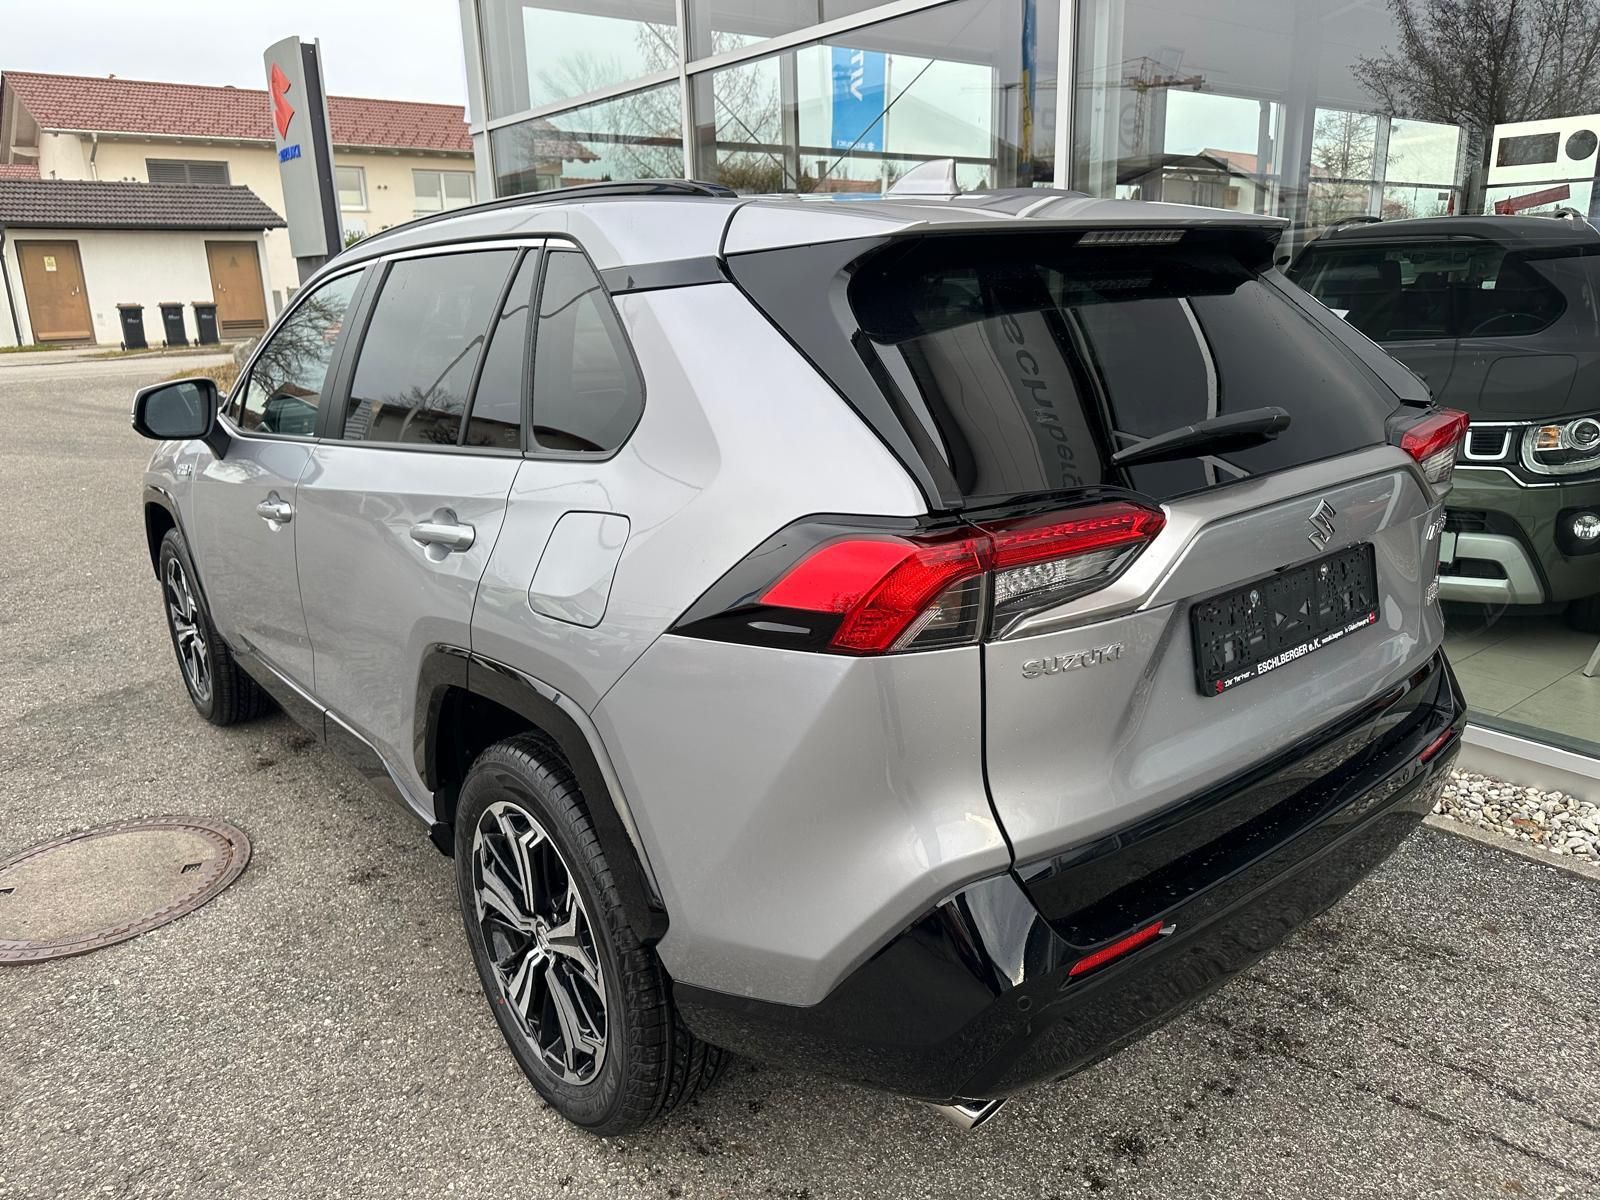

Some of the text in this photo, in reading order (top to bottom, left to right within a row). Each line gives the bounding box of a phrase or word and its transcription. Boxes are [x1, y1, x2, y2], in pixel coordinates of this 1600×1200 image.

[1022, 642, 1124, 679] SUZUKI
[1257, 645, 1308, 675] ESCHLBERGER
[1308, 638, 1322, 652] e.K.
